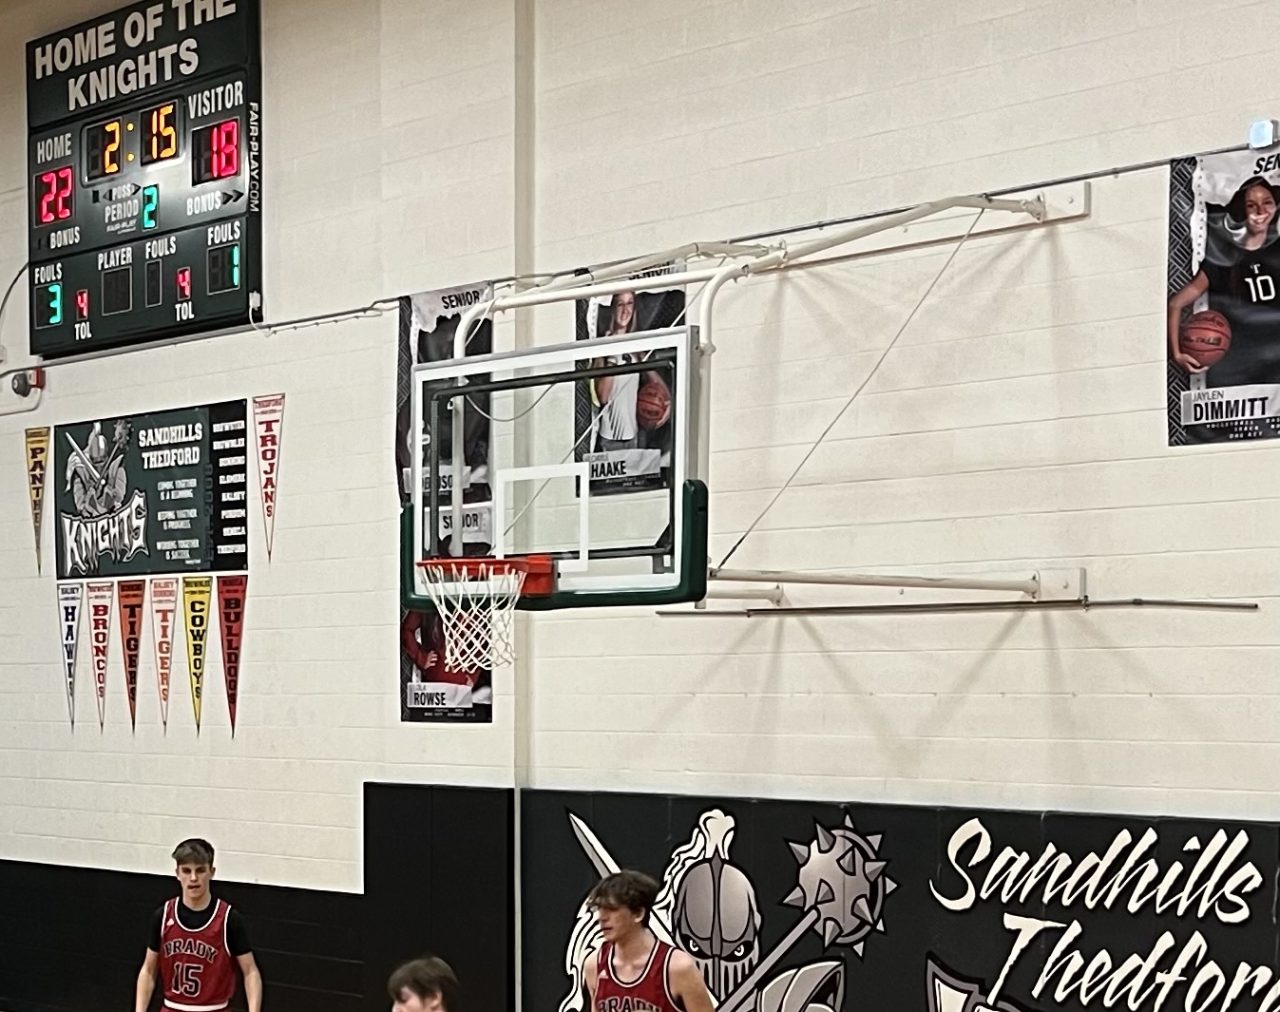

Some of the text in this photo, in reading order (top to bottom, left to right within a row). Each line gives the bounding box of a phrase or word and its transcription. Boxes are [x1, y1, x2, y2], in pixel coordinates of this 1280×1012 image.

[34, 0, 237, 79] HOME OF THE
[68, 38, 200, 111] KNIGHTS
[187, 80, 244, 120] VISITOR
[36, 132, 72, 165] HOME
[212, 120, 238, 178] 18
[39, 165, 72, 224] 22
[143, 186, 158, 228] 2
[186, 190, 222, 217] BONUS
[104, 199, 140, 223] PERIOD
[49, 226, 81, 250] BONUS
[207, 220, 241, 246] FOULS
[97, 246, 133, 271] PLAYER
[145, 236, 177, 260] FOULS
[34, 262, 63, 285] FOULS
[232, 245, 240, 287] 1
[177, 268, 191, 298] 4
[1244, 275, 1276, 302] 10
[49, 283, 62, 325] 3
[77, 290, 88, 319] 4
[175, 301, 195, 322] TOL
[441, 290, 480, 309] SENIOR
[74, 322, 92, 342] TOL
[1192, 390, 1225, 401] JAYLEN
[1193, 396, 1269, 422] DIMMITT
[138, 422, 203, 448] SANDHILLS
[141, 446, 200, 469] THEDFORD
[258, 419, 280, 518] TROJANS
[591, 460, 627, 478] HAAKE
[61, 490, 150, 577] KNIGHTS
[442, 513, 479, 530] SEIOR
[92, 605, 109, 698] BRONCOS
[123, 604, 142, 702] TIGERS
[155, 609, 174, 702] TIGERS
[189, 601, 206, 699] COWBOYS
[223, 598, 242, 704] BULLDOGS
[413, 692, 446, 706] ROWSE
[928, 817, 1263, 923] Sandhills
[163, 937, 219, 964] BRADY
[171, 961, 204, 998] 15
